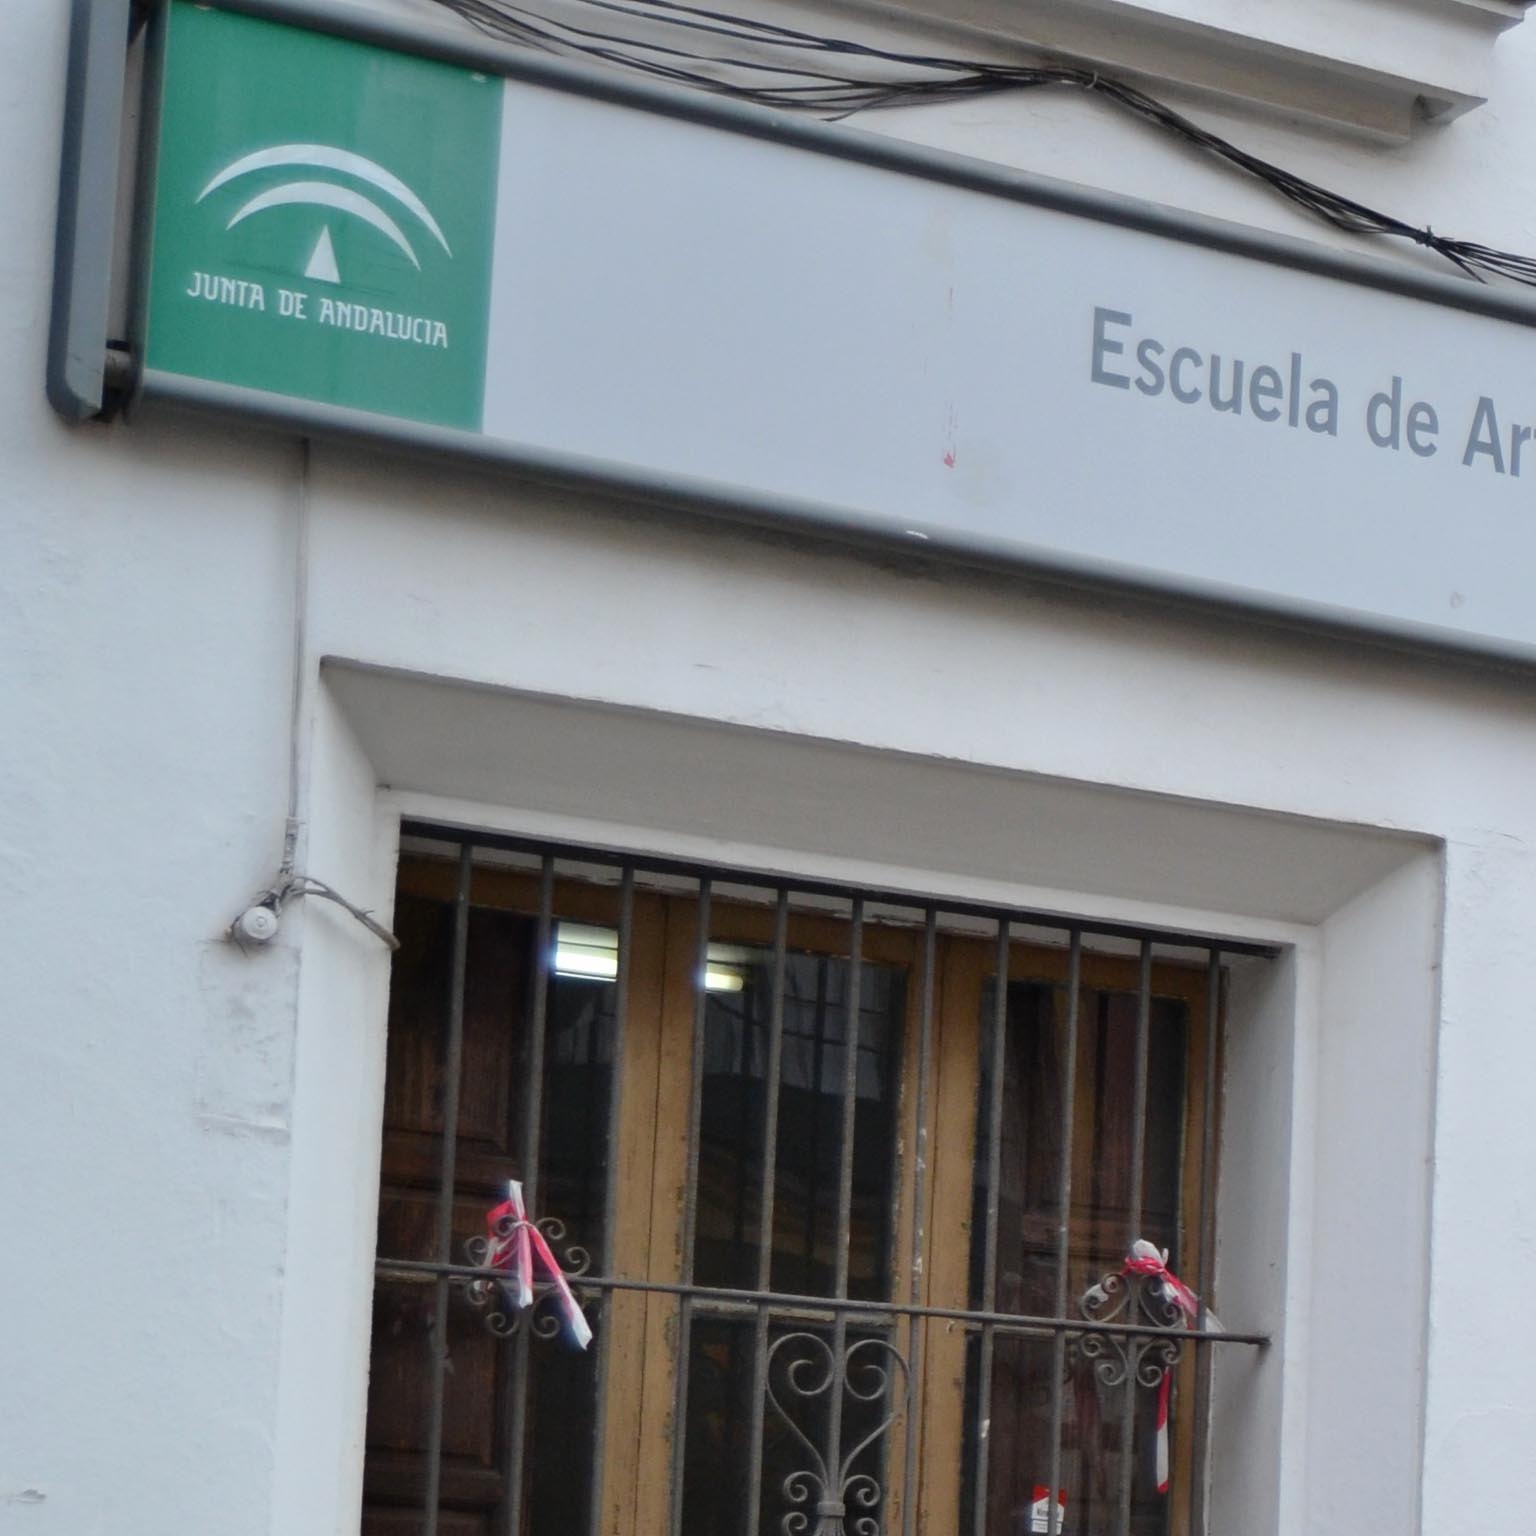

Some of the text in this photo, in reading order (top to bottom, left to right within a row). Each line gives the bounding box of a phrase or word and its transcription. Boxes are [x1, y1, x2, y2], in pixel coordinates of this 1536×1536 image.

[187, 271, 448, 349] JUNTA DE ANDALUCIA
[1089, 305, 1340, 438] Escuela
[1366, 375, 1440, 458] de
